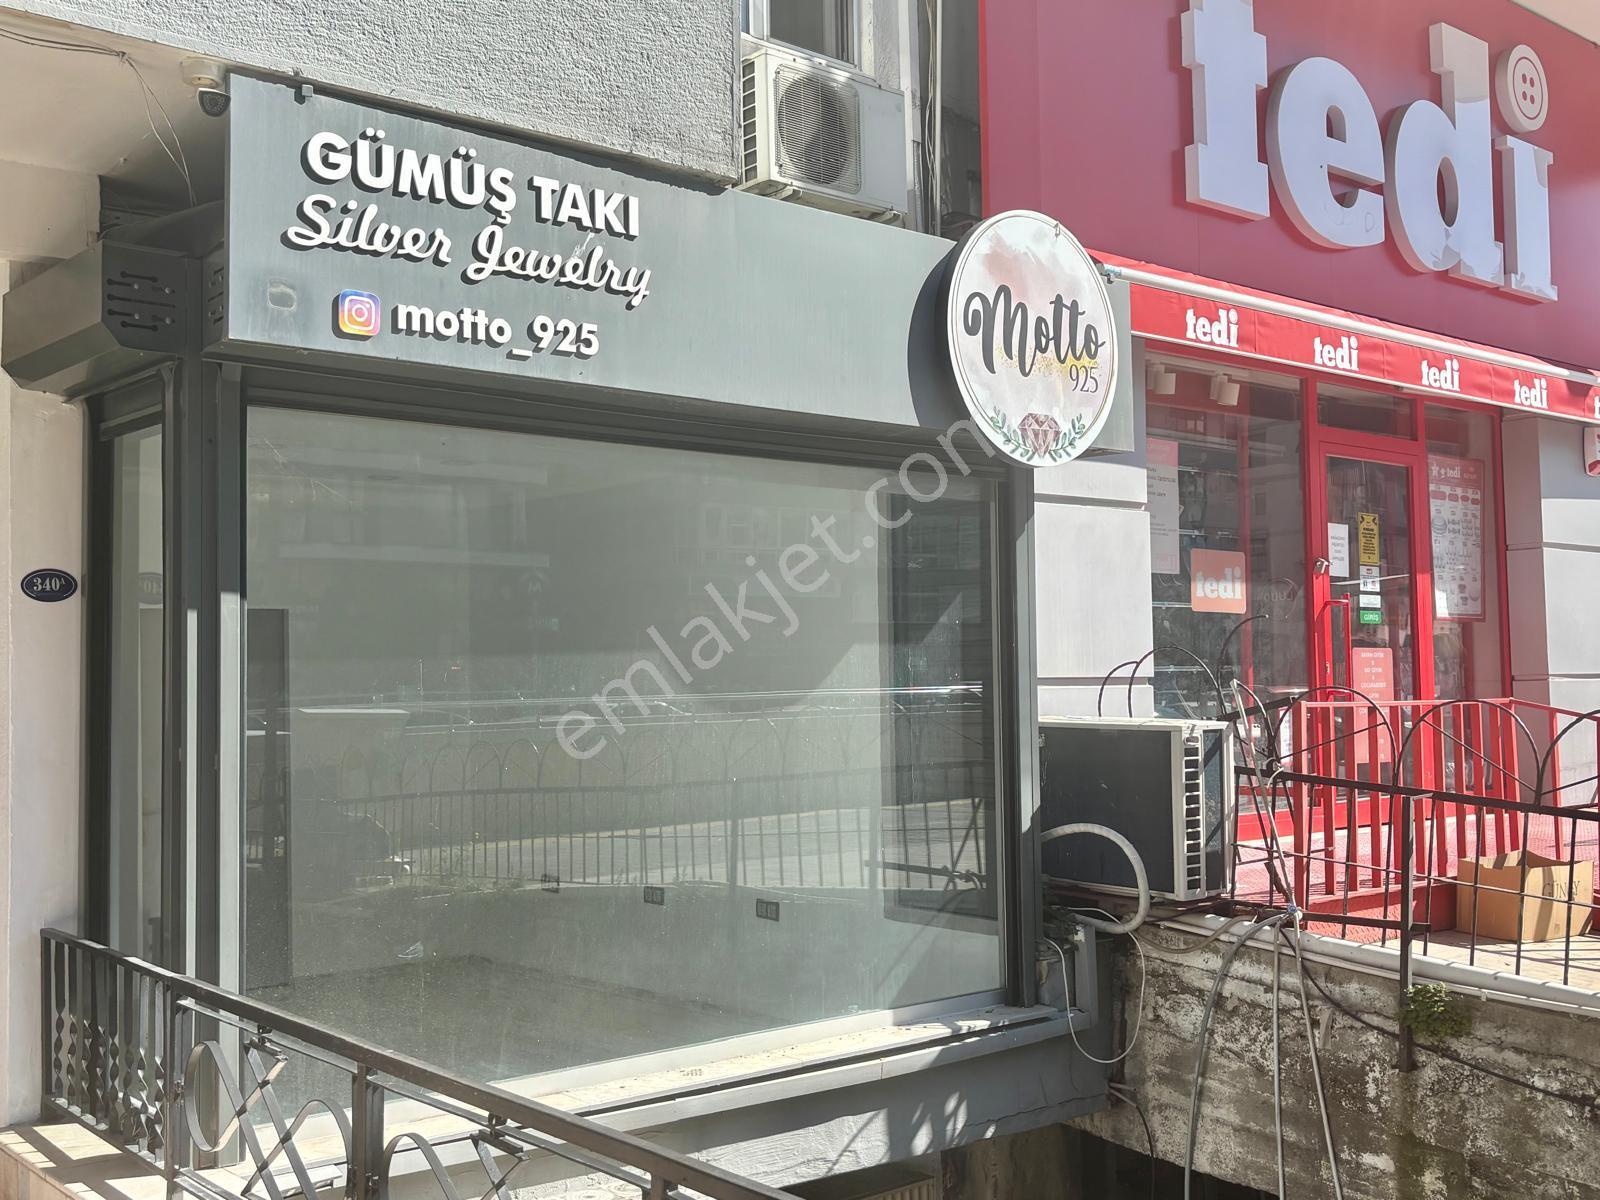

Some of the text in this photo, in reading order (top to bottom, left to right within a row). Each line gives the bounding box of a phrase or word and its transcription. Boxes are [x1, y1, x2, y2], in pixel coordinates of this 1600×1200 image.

[1181, 0, 1558, 302] tedi
[304, 127, 640, 239] GÜMÜŞ TAKI
[284, 193, 652, 308] Silver Jewelry
[395, 302, 600, 359] motto_925
[963, 284, 1106, 377] Motto
[1185, 307, 1239, 348] tedi
[1313, 336, 1359, 371] tedi
[1069, 364, 1099, 394] 925
[1420, 358, 1460, 391] tedi
[1513, 377, 1547, 409] tedi
[1195, 565, 1243, 600] tedi
